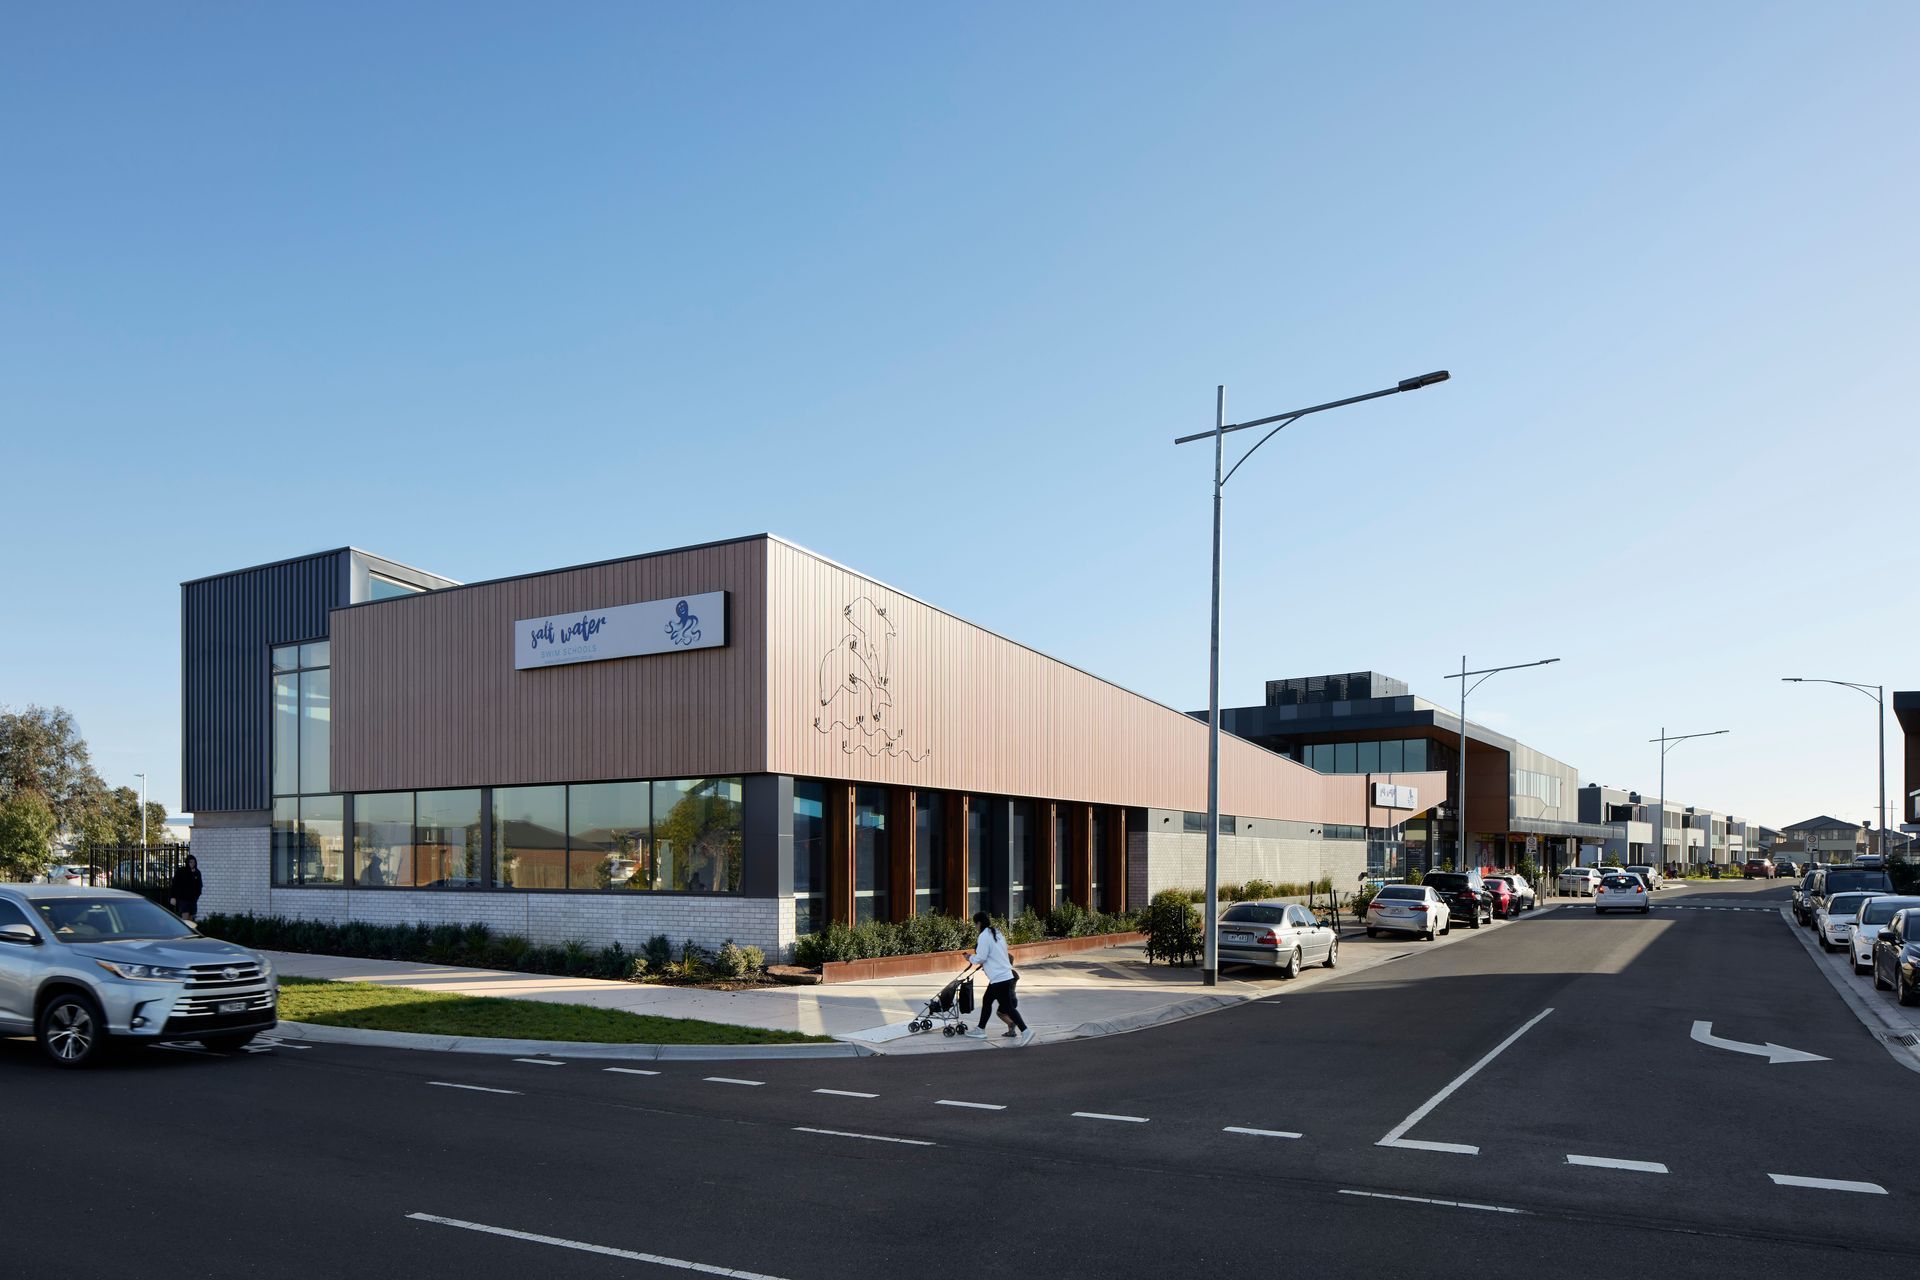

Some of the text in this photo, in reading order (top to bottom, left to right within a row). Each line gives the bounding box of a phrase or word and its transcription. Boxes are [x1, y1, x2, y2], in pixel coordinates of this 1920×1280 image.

[531, 615, 607, 649] salt water
[541, 644, 597, 659] SWIM SCHOOLS
